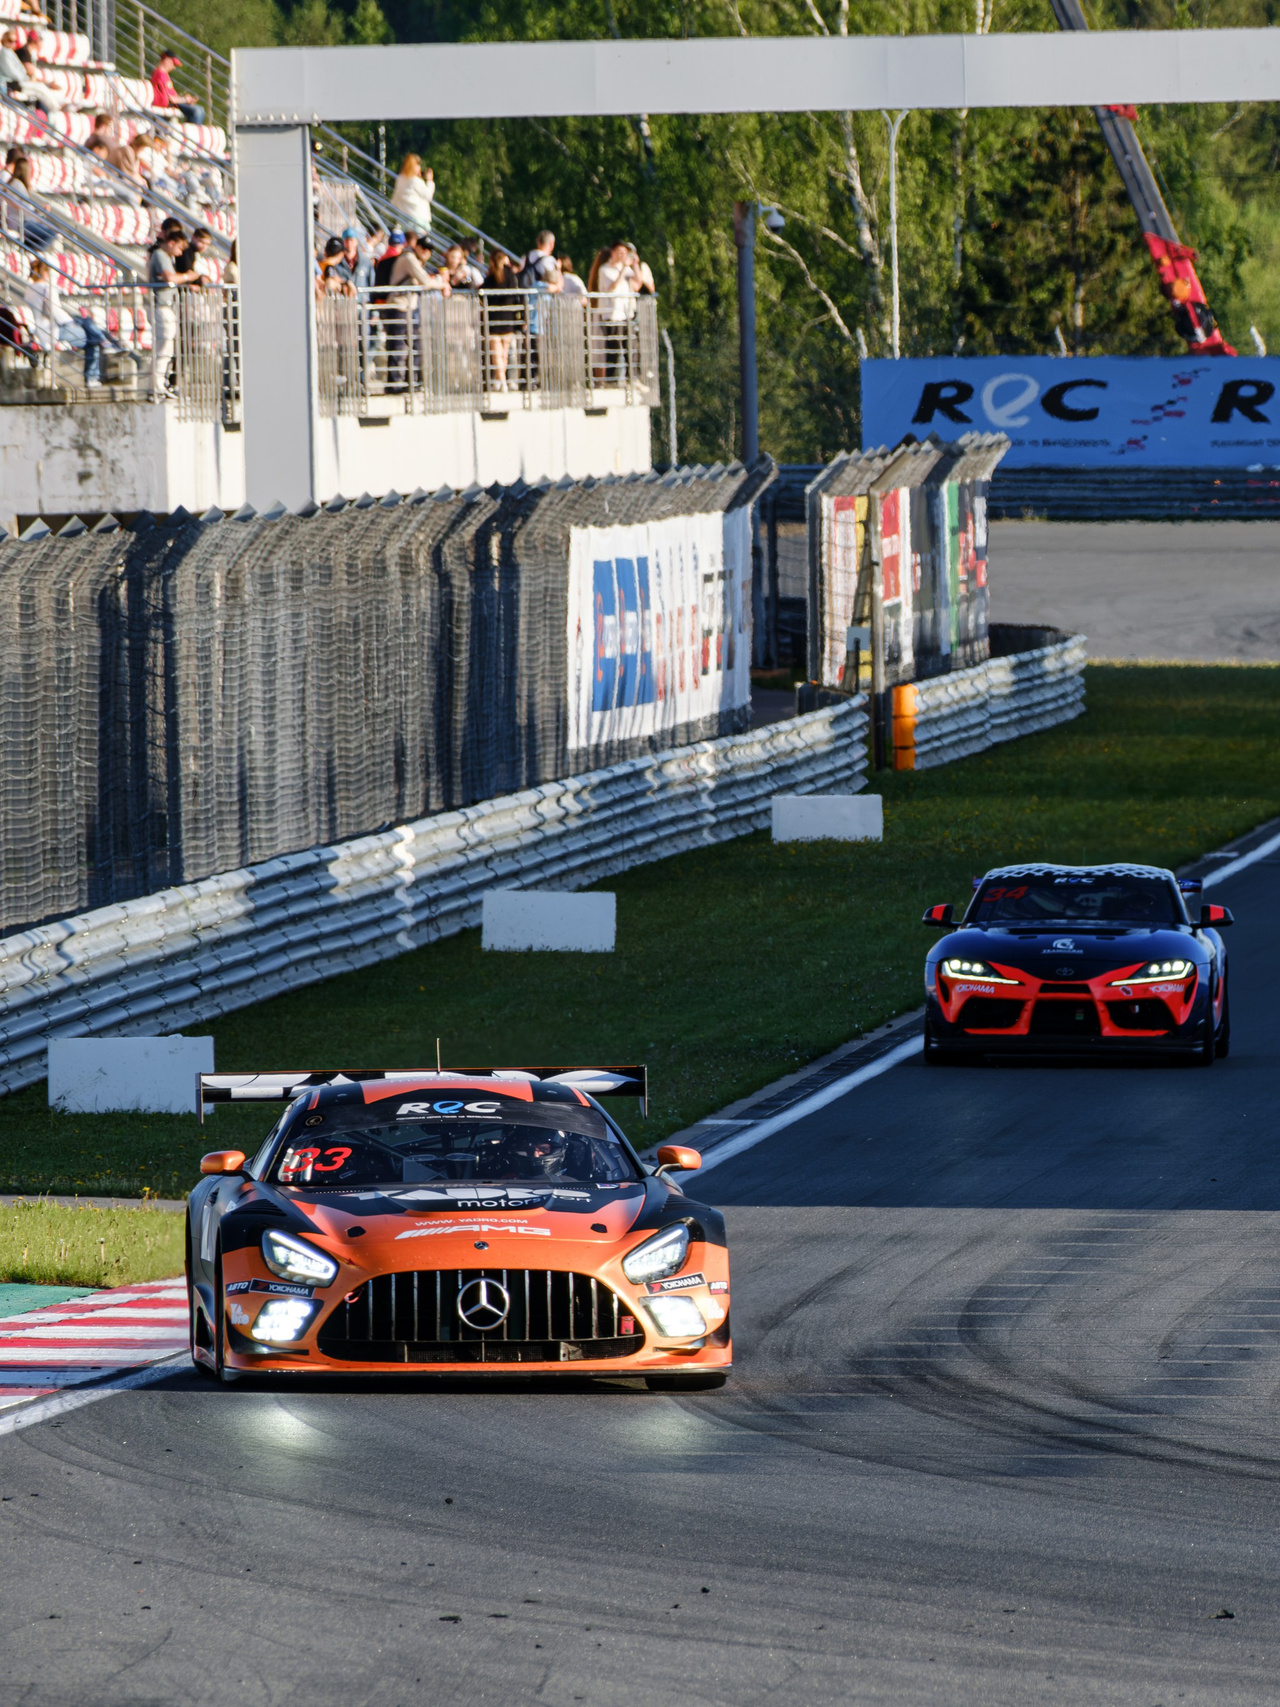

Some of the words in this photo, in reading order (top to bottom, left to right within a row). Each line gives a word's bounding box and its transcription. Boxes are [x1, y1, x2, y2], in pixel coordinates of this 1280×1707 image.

[982, 886, 1029, 901] 34
[284, 1147, 352, 1172] 33
[662, 1276, 702, 1289] YOKOHAMA
[269, 1284, 309, 1296] YOKOHAMA
